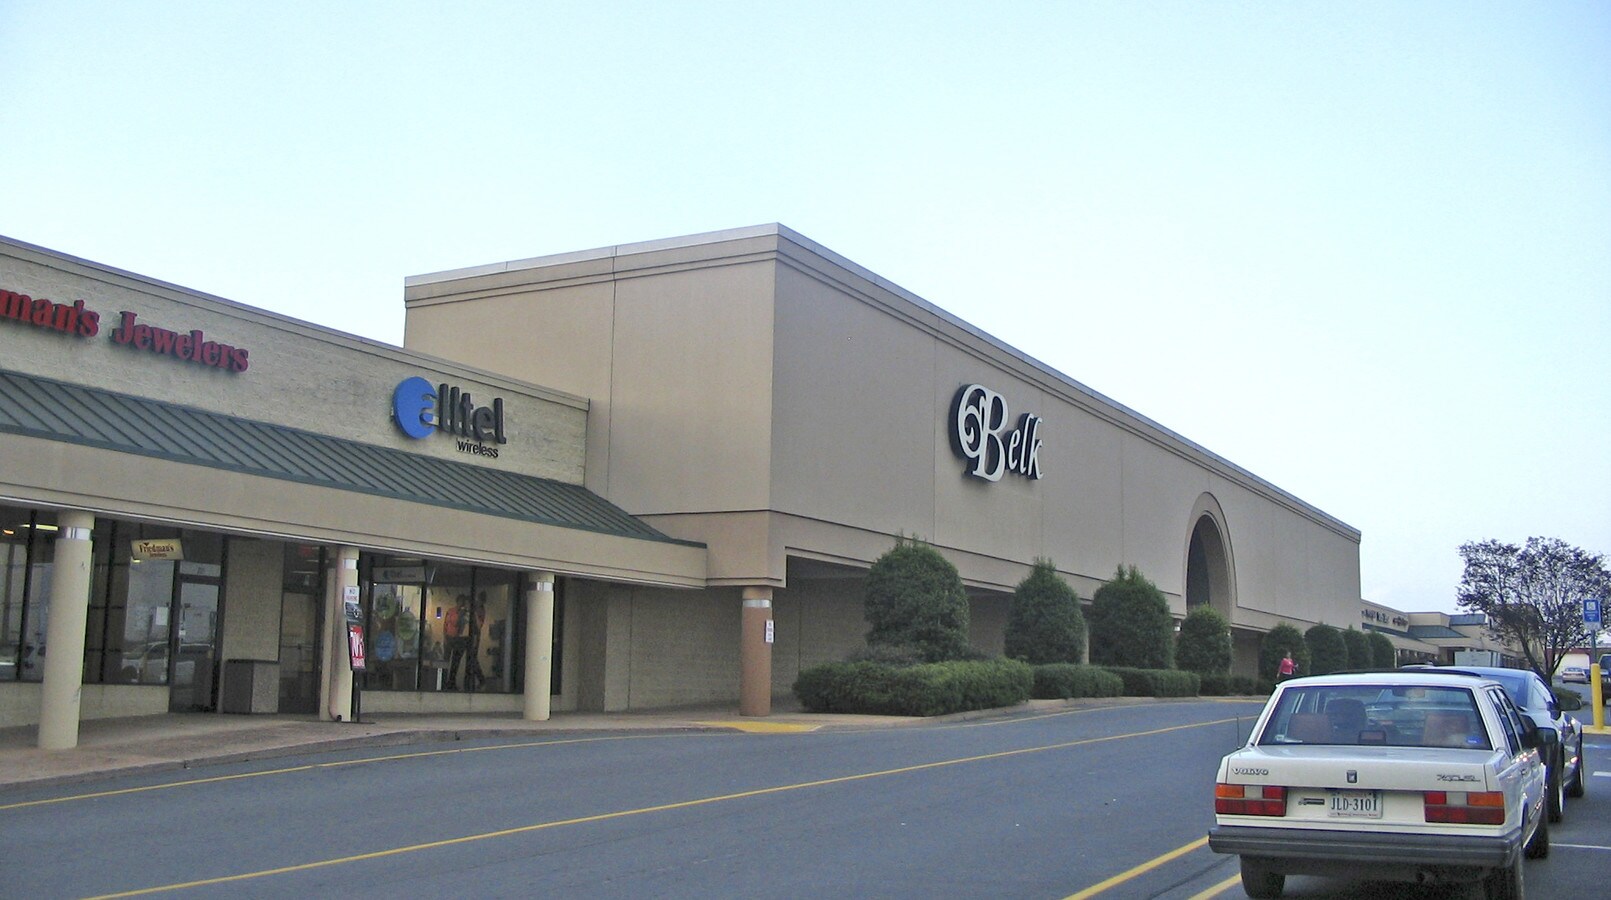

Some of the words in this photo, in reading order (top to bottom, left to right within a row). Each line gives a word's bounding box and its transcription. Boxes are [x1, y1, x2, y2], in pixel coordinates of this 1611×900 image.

[110, 310, 249, 373] Jewelers
[949, 384, 1044, 482] Belk
[456, 439, 499, 459] wireless
[1232, 768, 1269, 776] VOLVO
[1331, 797, 1377, 811] JLD-3101
